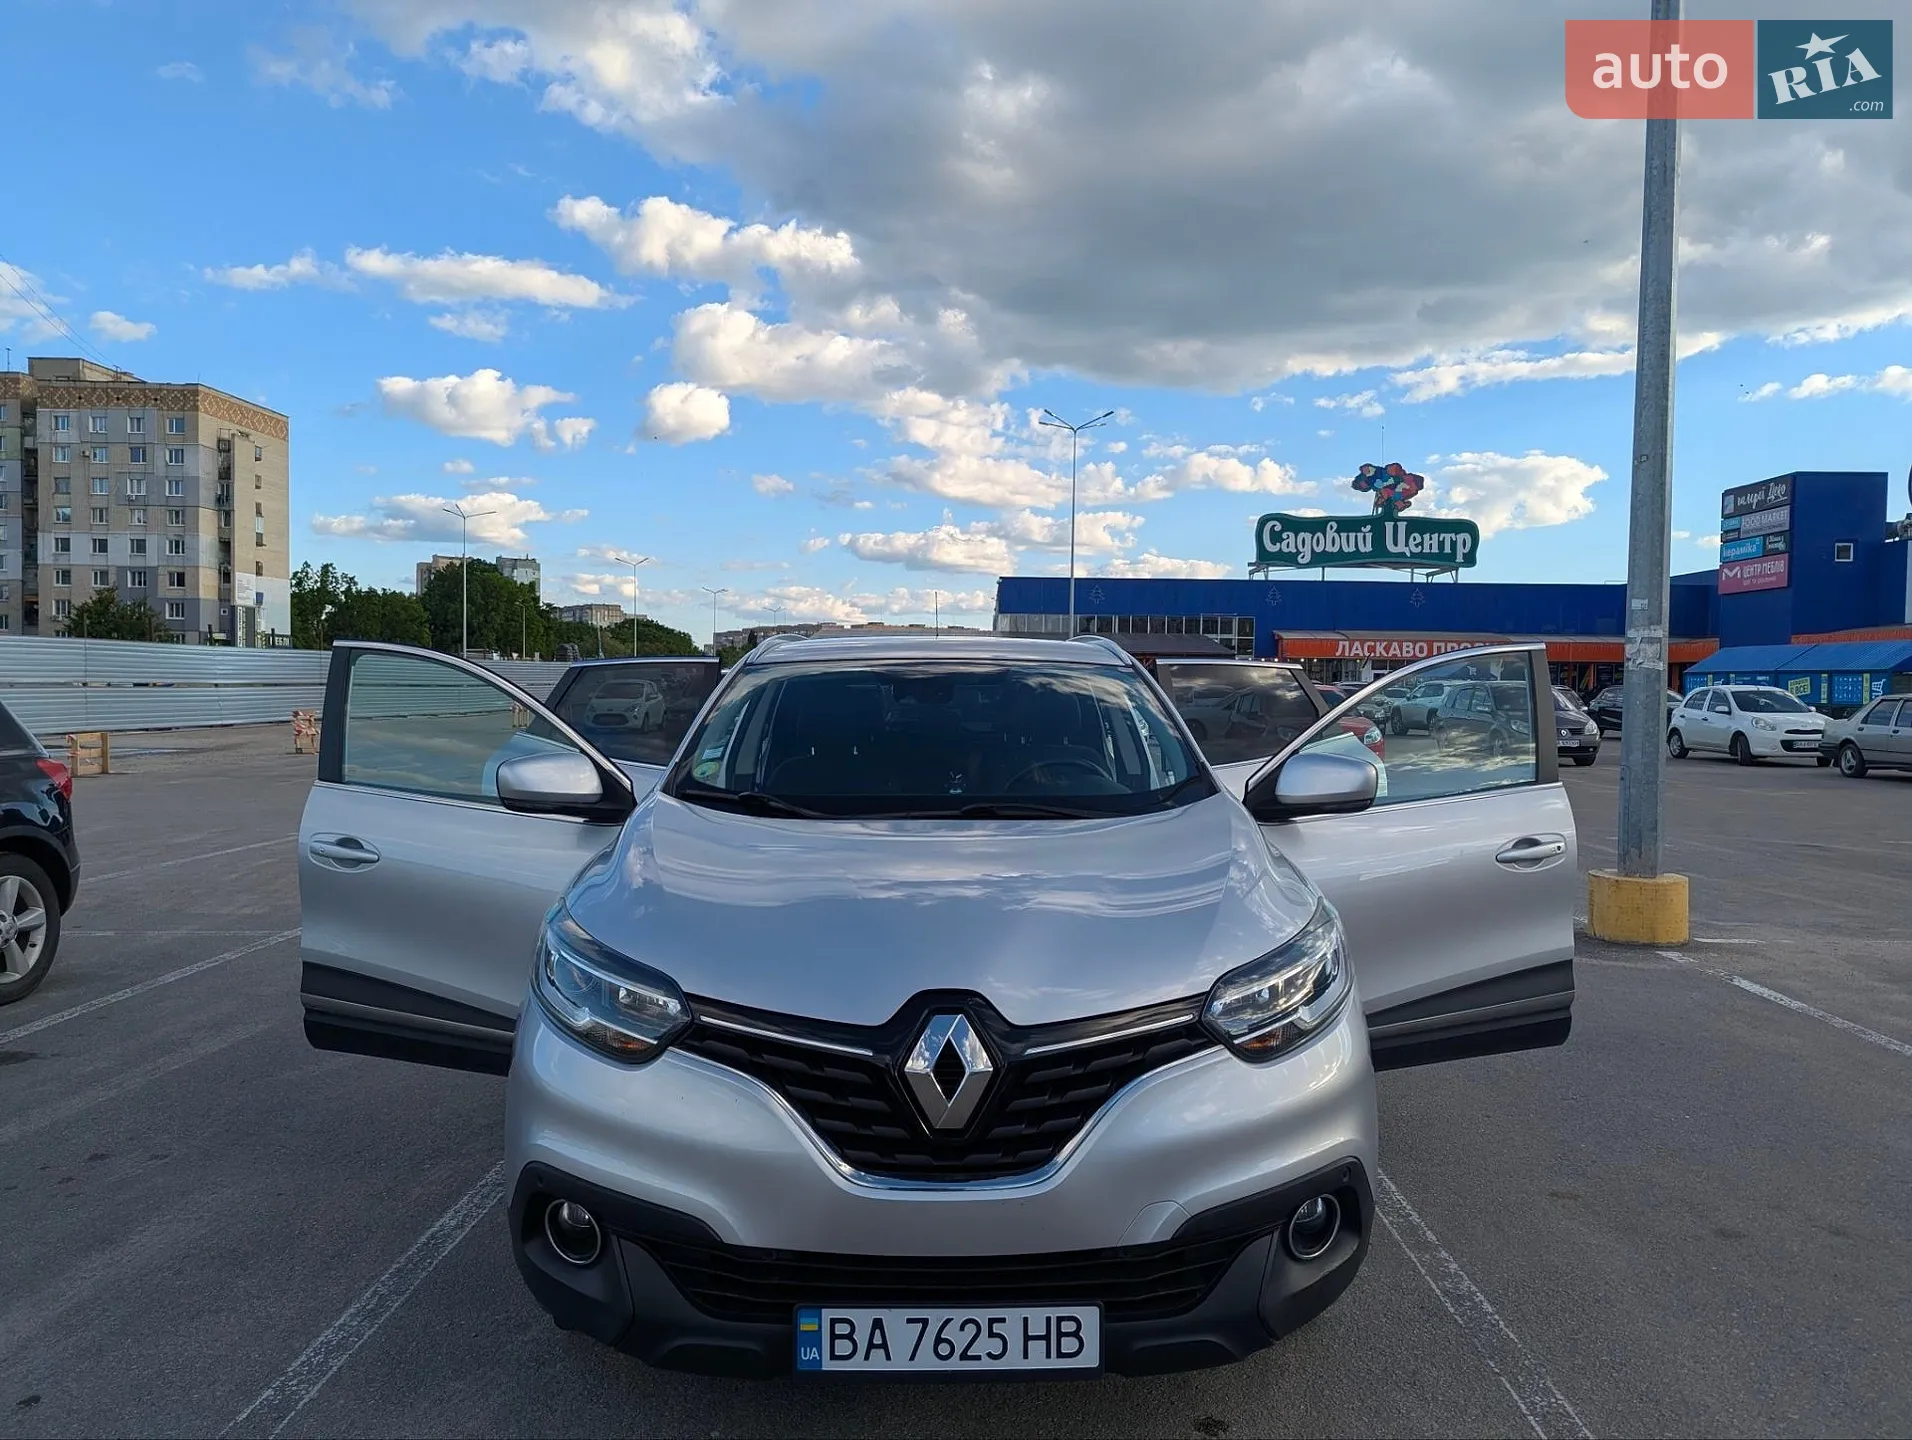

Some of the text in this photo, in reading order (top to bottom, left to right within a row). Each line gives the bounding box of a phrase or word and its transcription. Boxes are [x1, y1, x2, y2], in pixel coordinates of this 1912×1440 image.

[1262, 520, 1472, 564] Садовий Центр
[1335, 641, 1428, 658] ЛАСКАВО
[828, 1315, 1085, 1361] BA 7625 HB
[801, 1347, 820, 1360] UA
